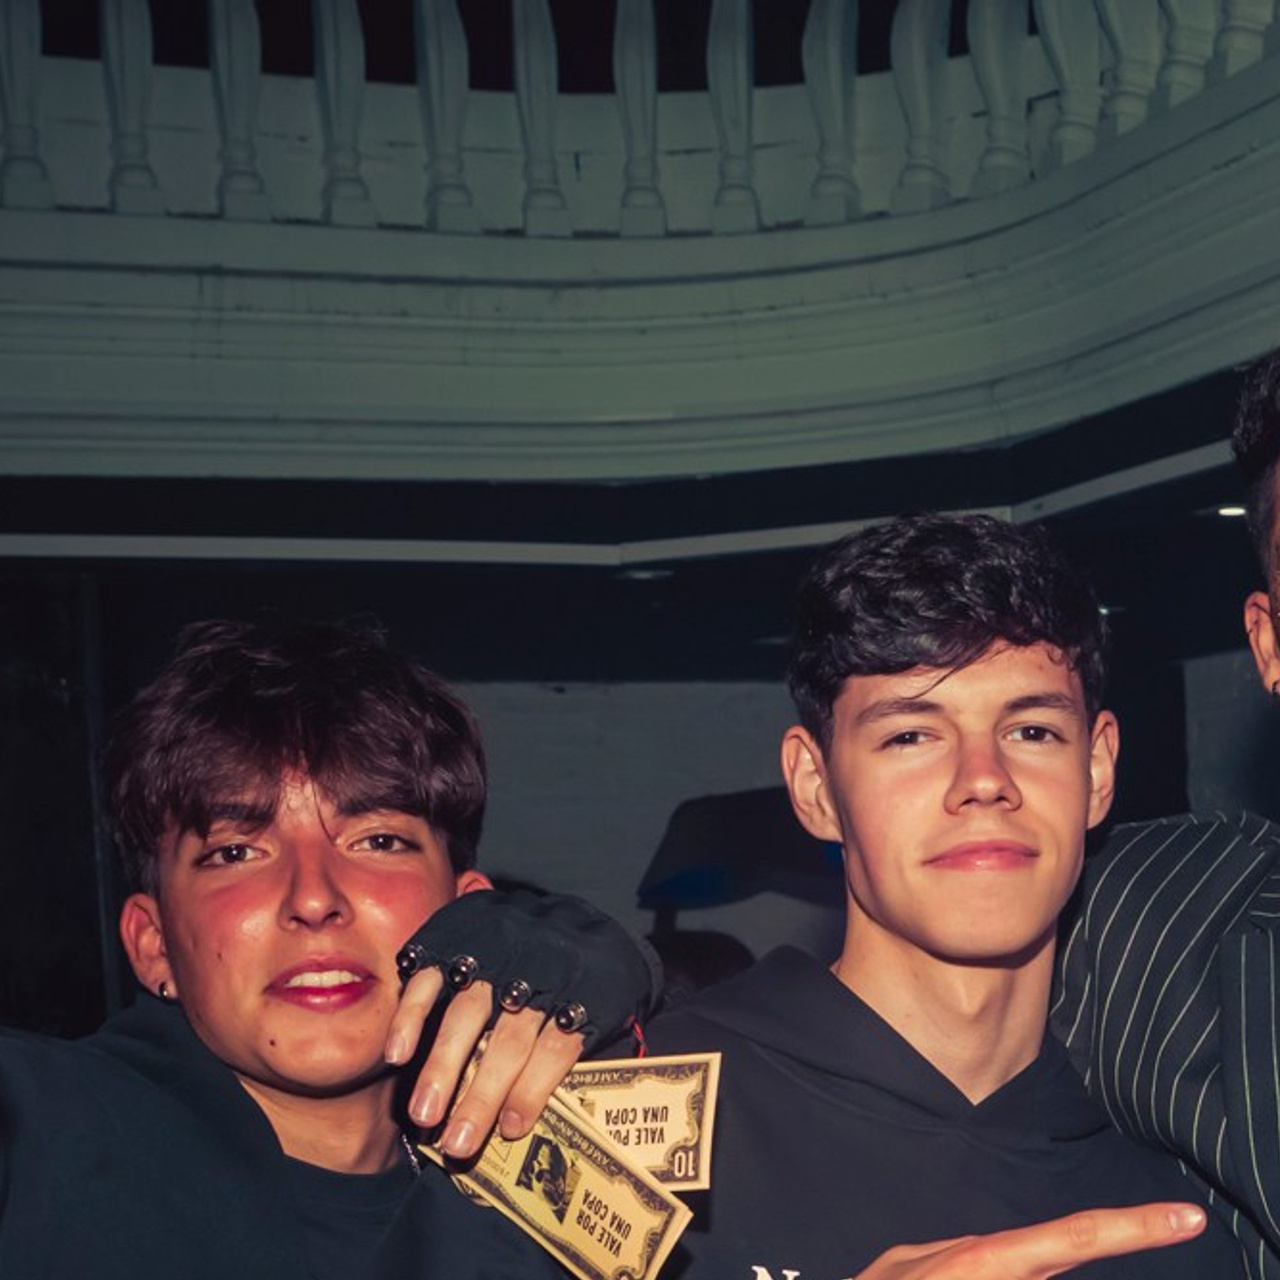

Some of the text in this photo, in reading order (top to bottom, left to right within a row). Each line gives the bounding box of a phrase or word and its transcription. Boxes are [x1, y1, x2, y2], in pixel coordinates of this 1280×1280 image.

[605, 1106, 669, 1126] UNA COPA
[608, 1127, 665, 1146] VALE PO
[674, 1150, 695, 1177] 10
[582, 1189, 632, 1240] UNA COPA
[576, 1207, 622, 1258] VALE POR
